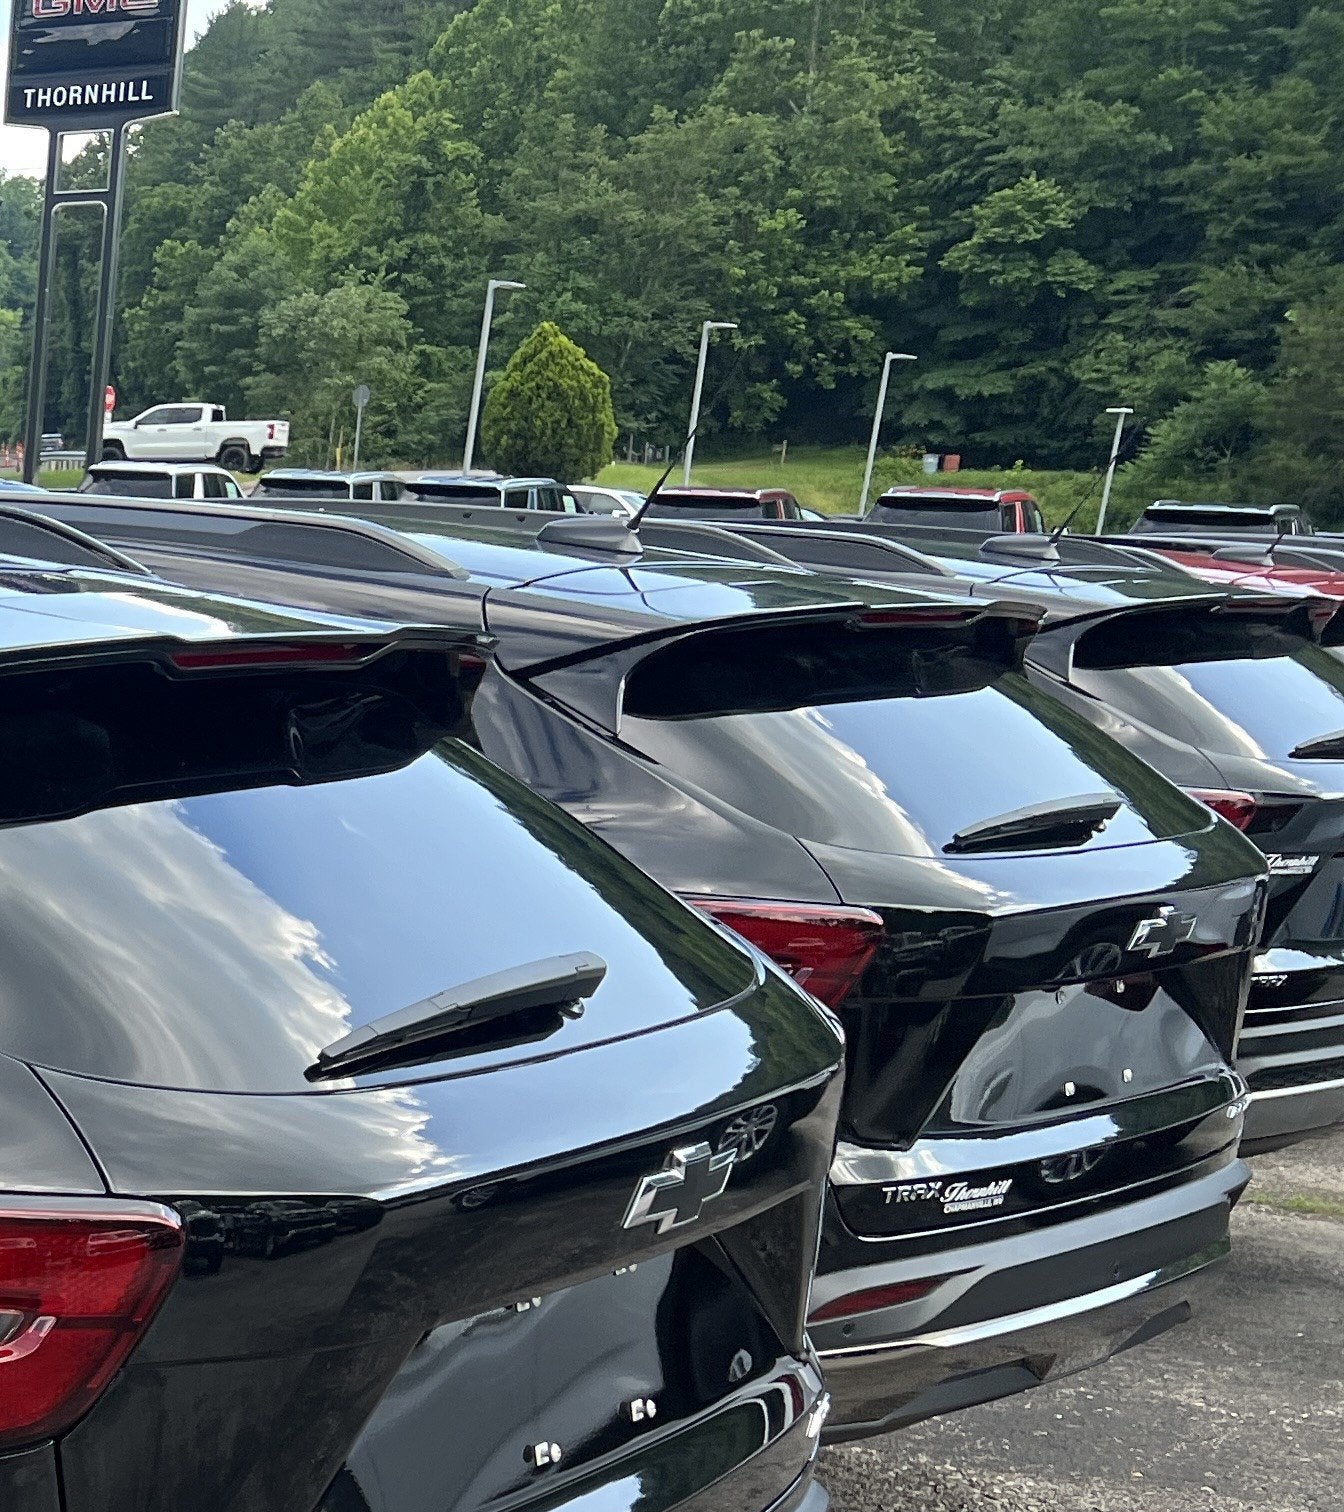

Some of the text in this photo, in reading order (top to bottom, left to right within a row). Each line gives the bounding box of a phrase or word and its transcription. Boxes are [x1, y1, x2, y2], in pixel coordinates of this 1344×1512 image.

[23, 80, 154, 109] THORNHILL
[881, 1178, 1013, 1204] TRAX Thornhill
